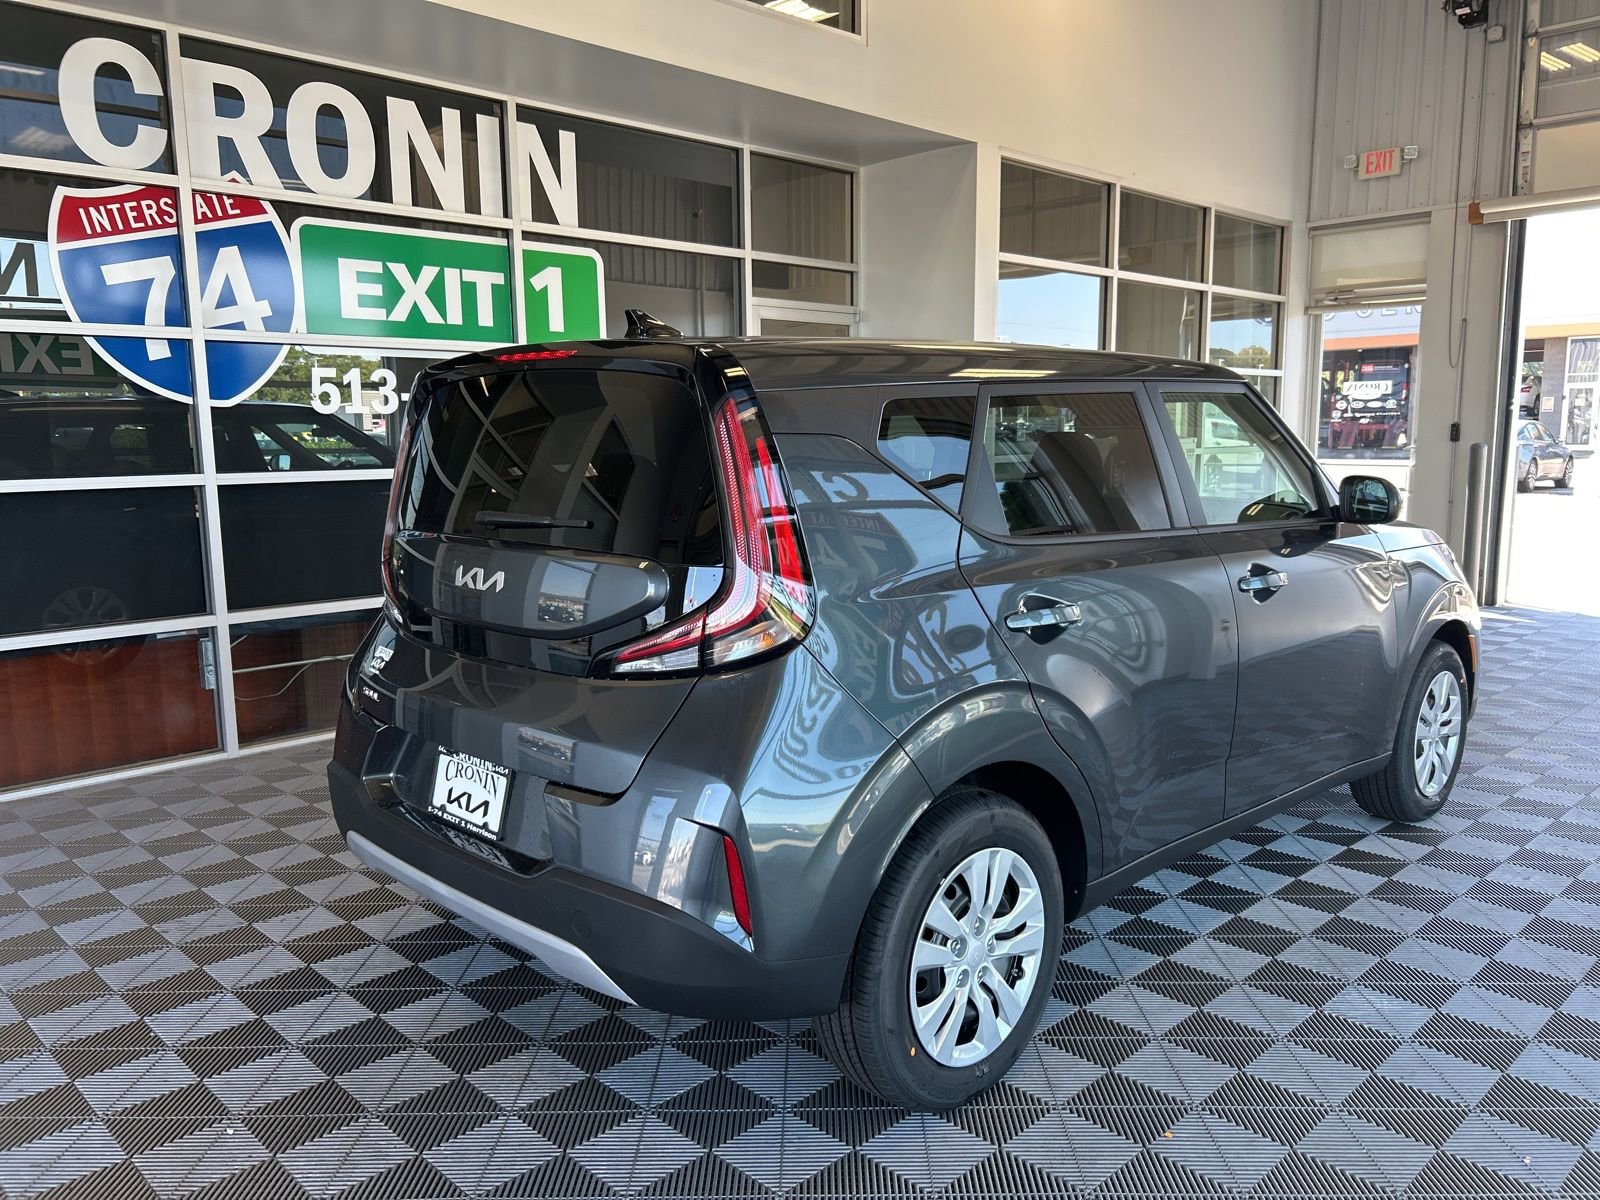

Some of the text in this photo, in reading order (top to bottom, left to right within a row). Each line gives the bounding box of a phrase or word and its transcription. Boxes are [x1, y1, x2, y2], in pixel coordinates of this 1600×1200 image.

[57, 37, 579, 228] CRONIN
[1365, 149, 1394, 175] EXIT
[79, 192, 241, 235] INTERSATE
[100, 245, 273, 361] 74
[337, 257, 566, 333] EXIT 1
[455, 564, 504, 593] KIA
[445, 759, 500, 800] CRONIN
[446, 786, 490, 819] KIA
[443, 812, 460, 824] EXIT
[466, 823, 497, 841] Harrison
